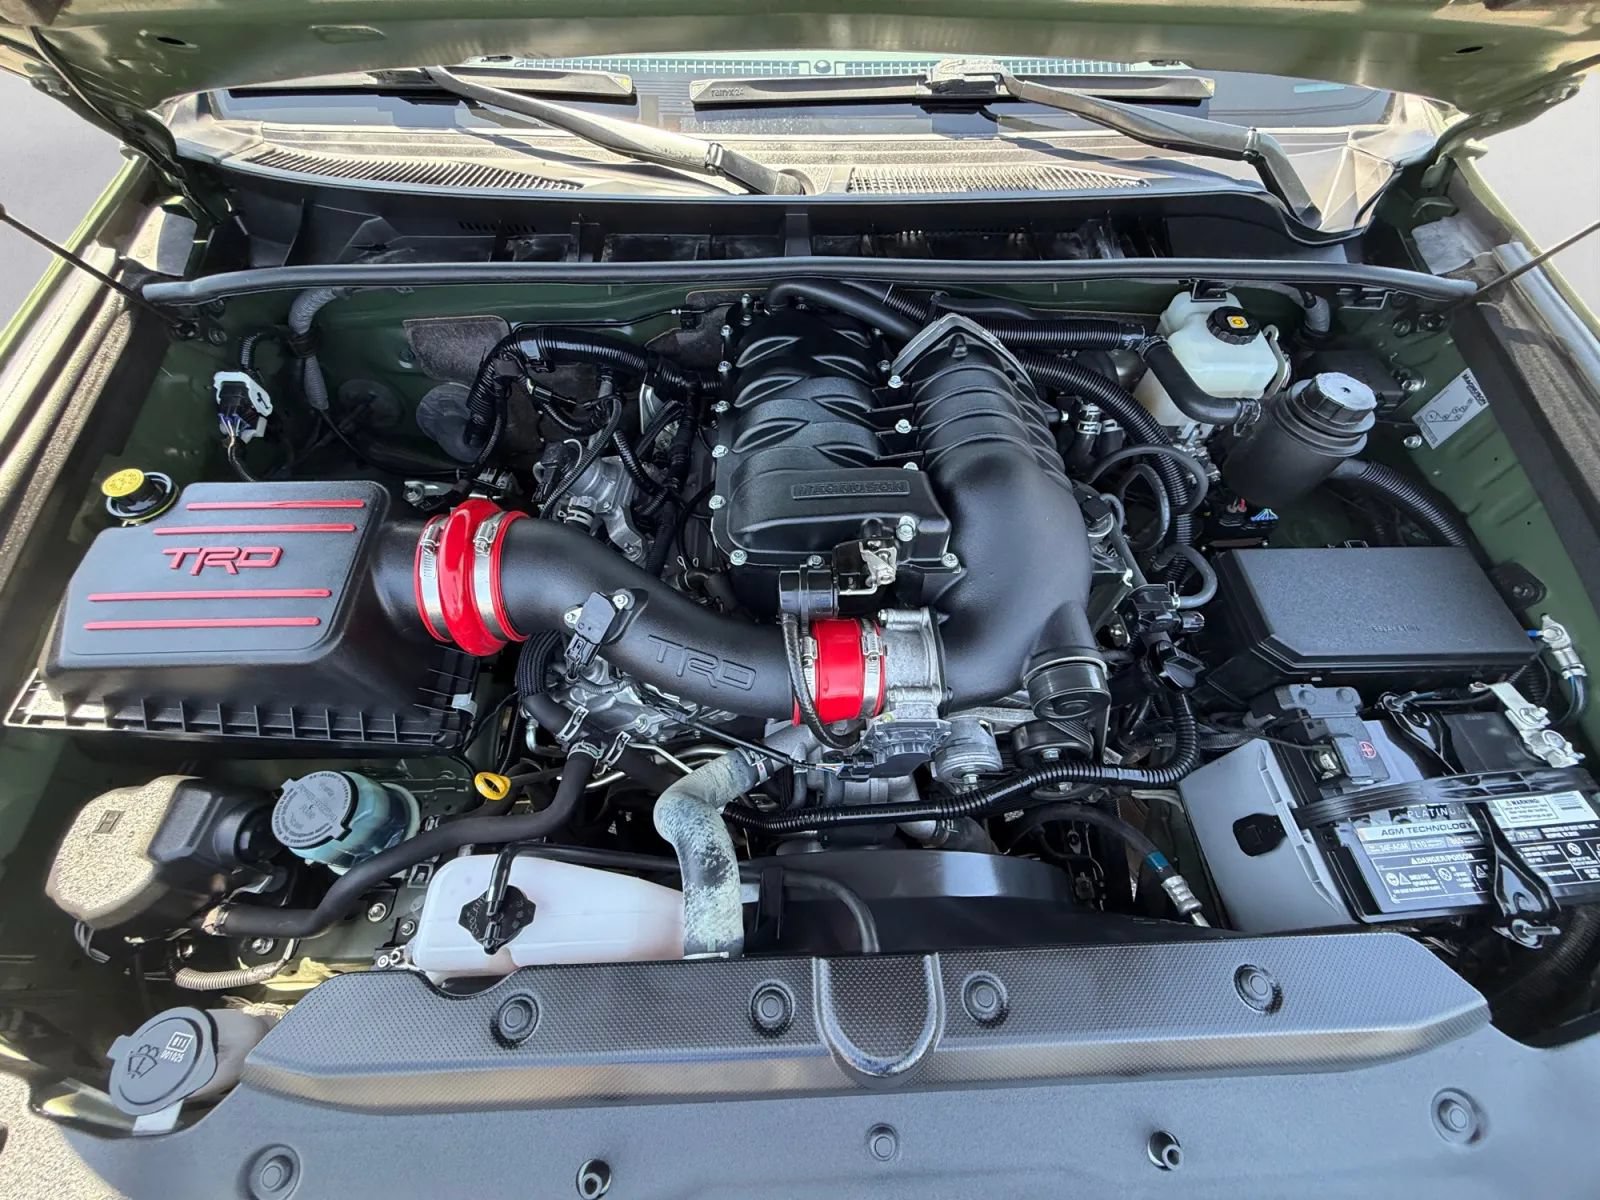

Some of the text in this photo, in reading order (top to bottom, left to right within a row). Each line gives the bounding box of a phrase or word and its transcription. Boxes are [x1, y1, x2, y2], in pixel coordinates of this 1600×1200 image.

[162, 545, 284, 577] TRD
[647, 634, 757, 691] TRD
[1406, 806, 1466, 819] PLATINUM
[1380, 821, 1473, 837] AGM TECHNOLOGY
